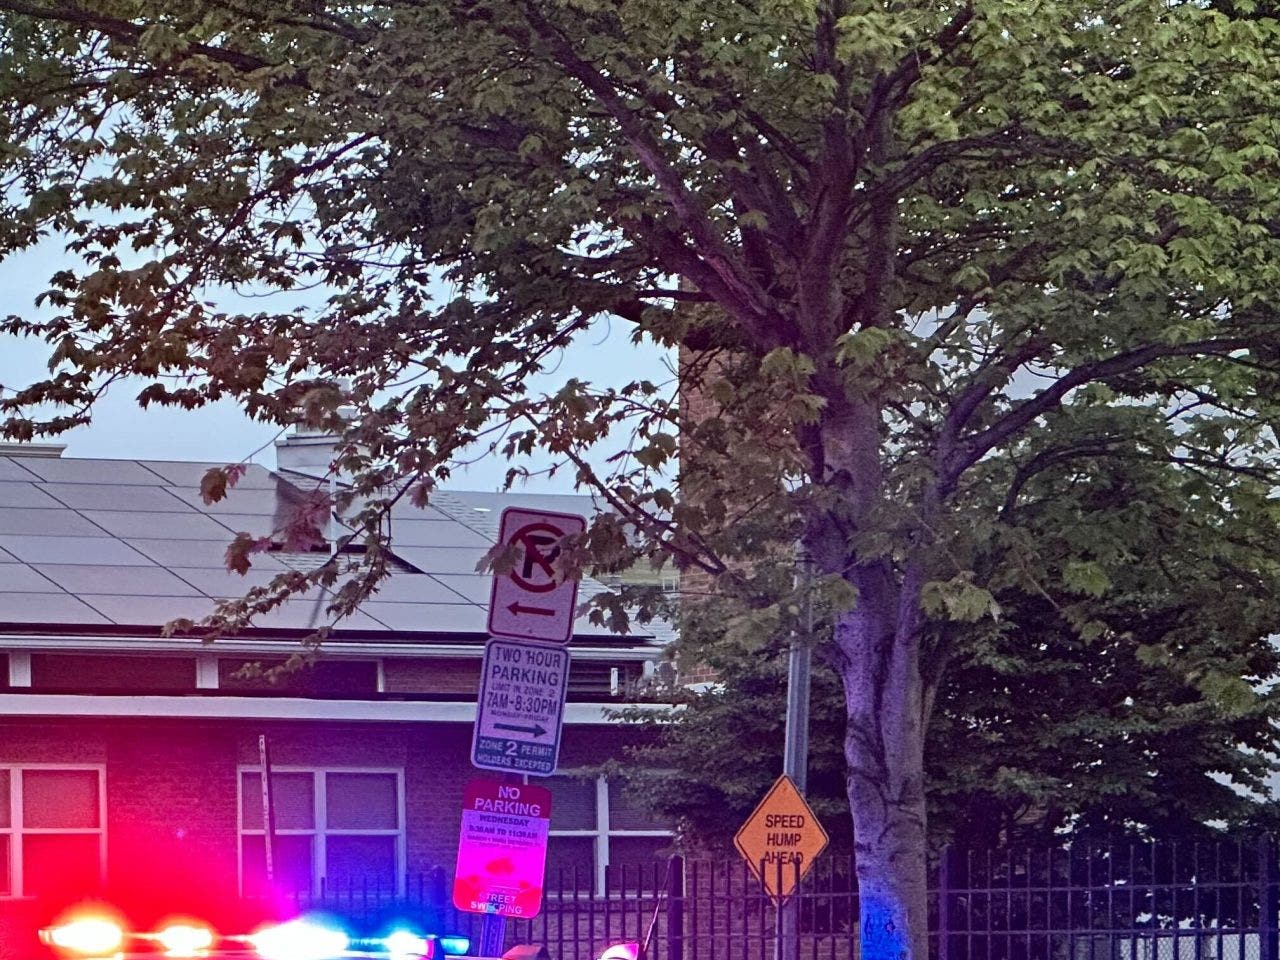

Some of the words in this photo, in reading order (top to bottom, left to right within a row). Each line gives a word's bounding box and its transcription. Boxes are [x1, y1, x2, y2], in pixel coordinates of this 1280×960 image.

[495, 646, 521, 663] TWO
[525, 649, 561, 668] HOUR
[491, 664, 559, 687] PARKING
[524, 686, 543, 697] ZONE
[549, 688, 555, 698] 2
[479, 739, 503, 751] ZONE
[505, 740, 518, 756] 2
[521, 744, 553, 757] PERMIT
[477, 753, 512, 767] HOLDERS
[514, 758, 552, 772] EXCEPTED
[498, 785, 521, 800] NO
[474, 797, 541, 817] PARKING
[479, 814, 530, 827] WEDNESDAY
[765, 814, 805, 828] SPEED
[766, 833, 802, 847] HUMP
[763, 851, 804, 865] AHEAD
